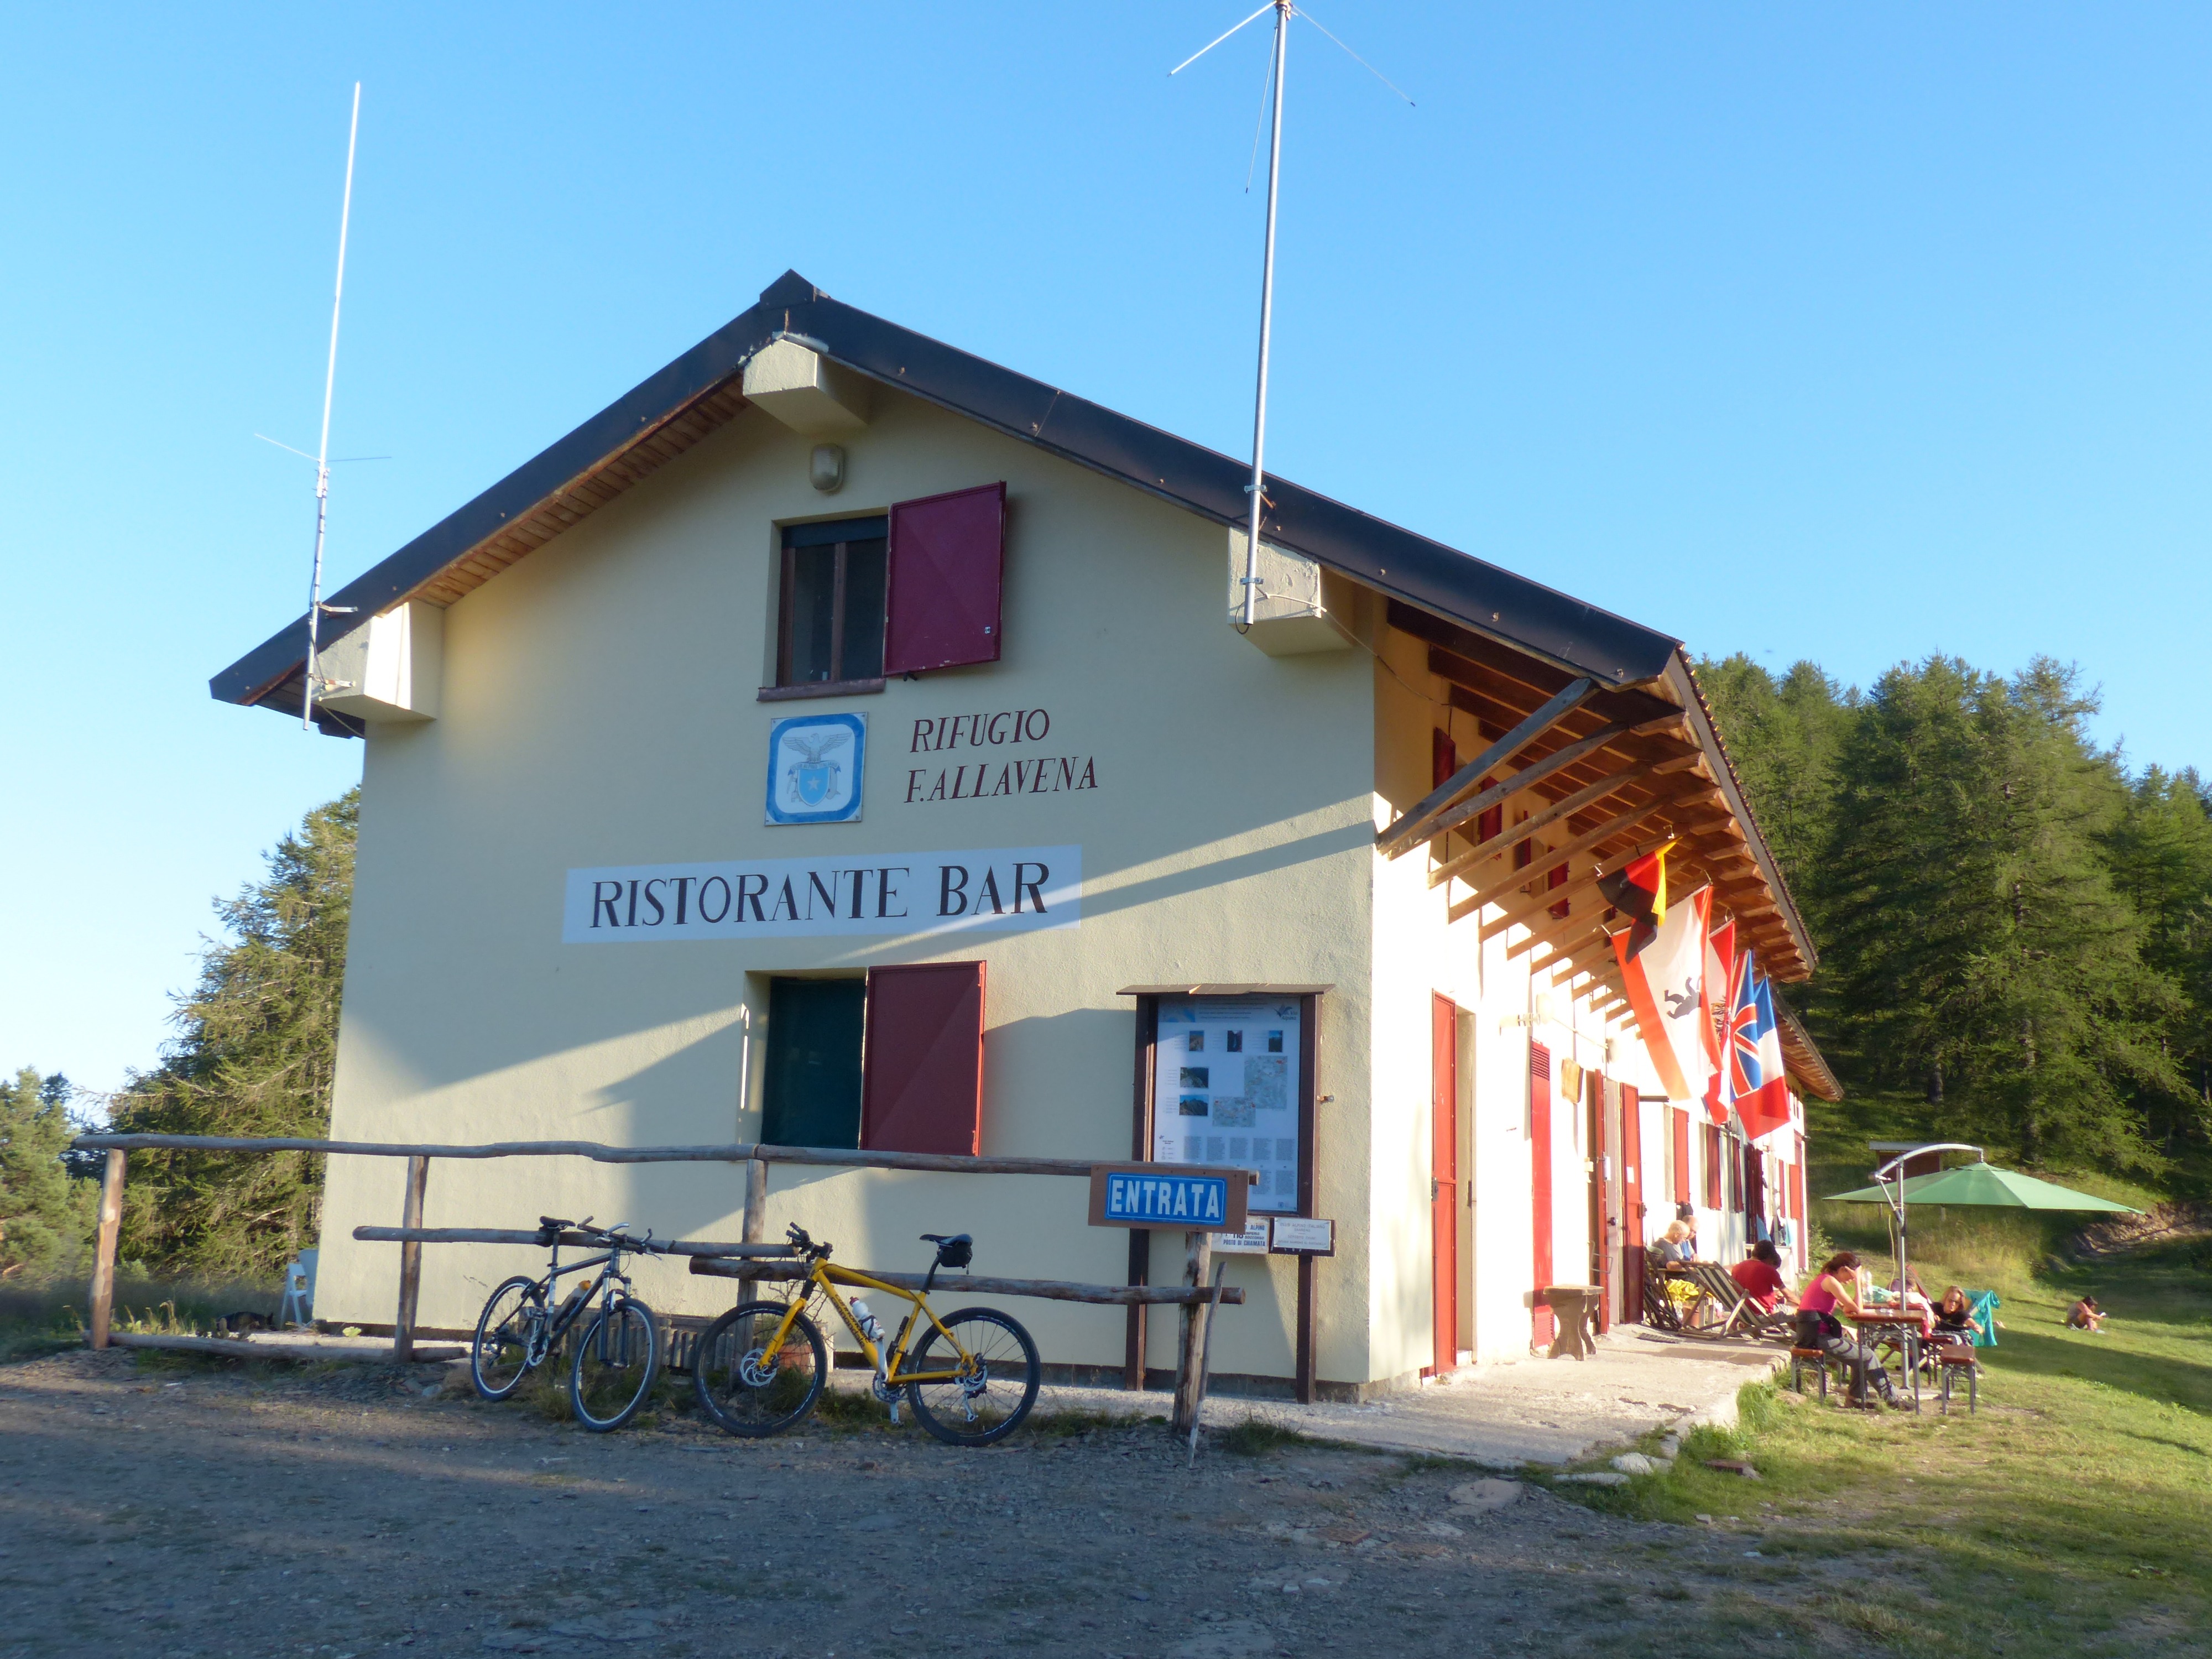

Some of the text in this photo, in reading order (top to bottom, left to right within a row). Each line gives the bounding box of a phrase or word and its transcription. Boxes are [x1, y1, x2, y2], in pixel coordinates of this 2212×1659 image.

[909, 708, 1050, 753] RIFUGIO
[904, 755, 1098, 803] F.ALLAVENA
[589, 862, 1050, 928] RISTORANTE BAR
[1111, 1179, 1219, 1218] ENTRATA
[831, 1297, 865, 1347] cannondale
